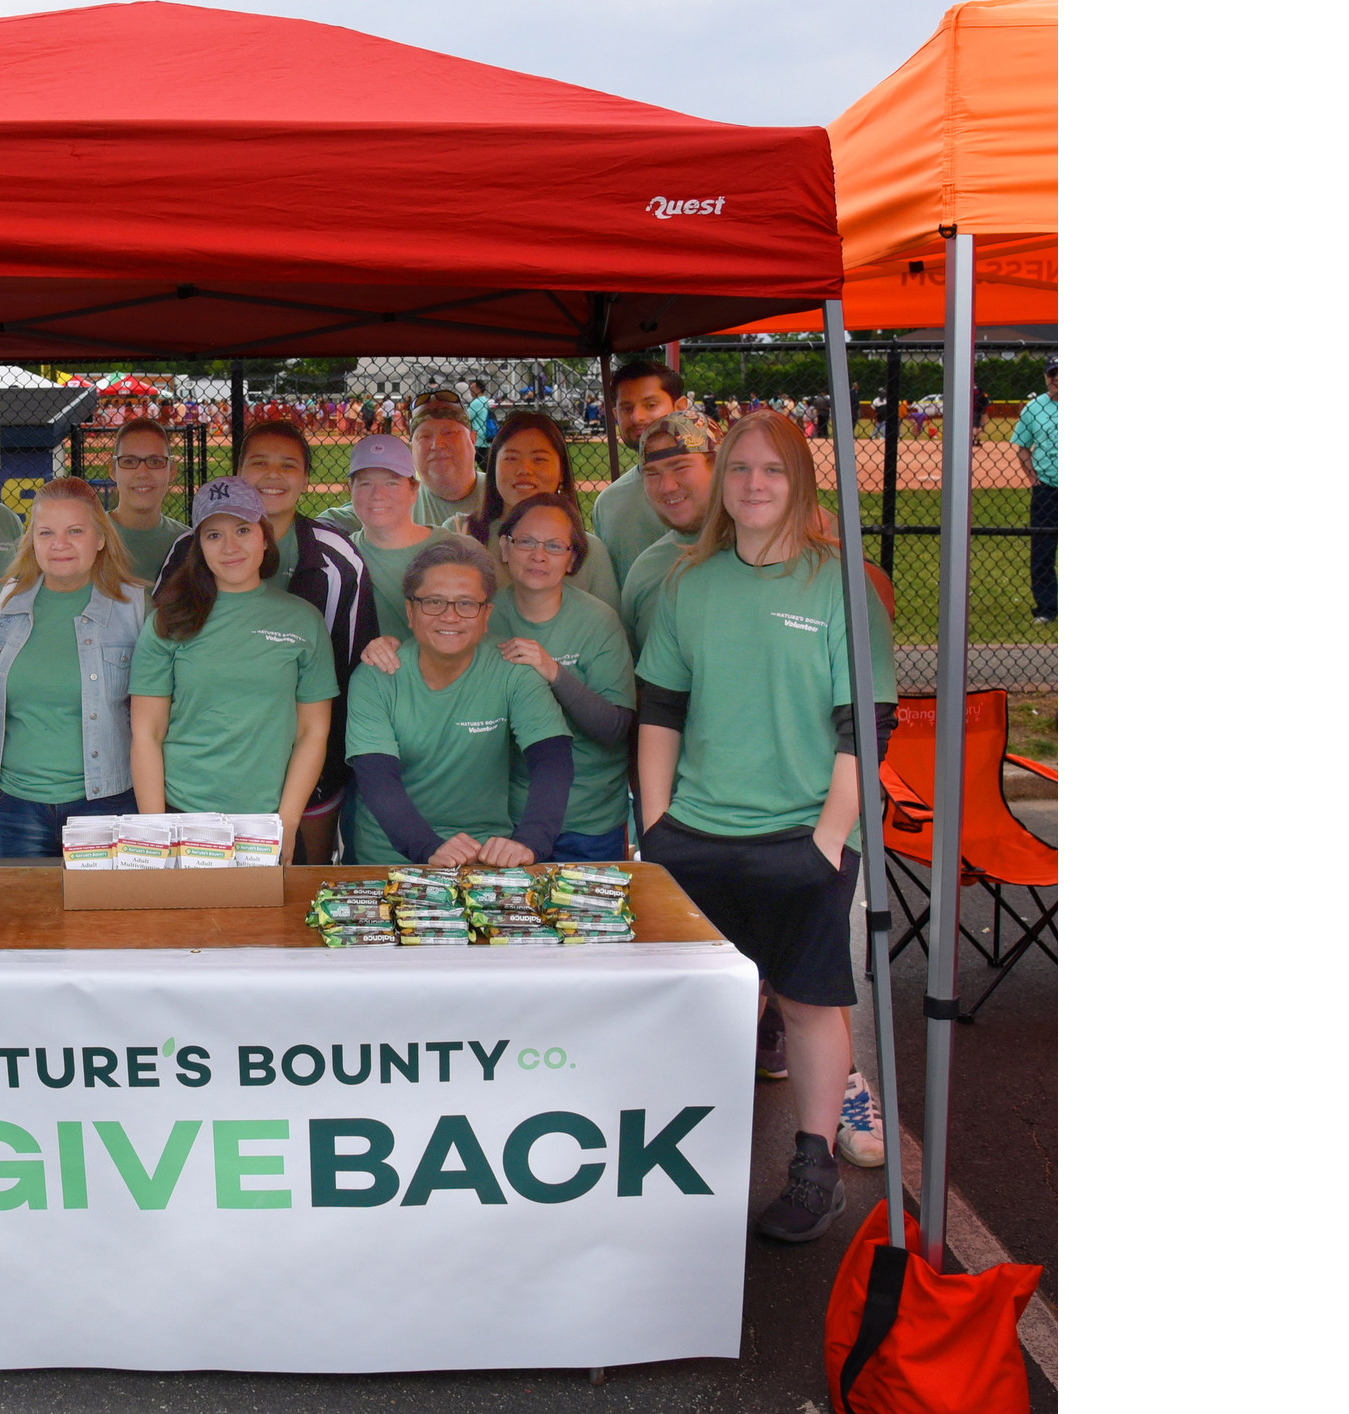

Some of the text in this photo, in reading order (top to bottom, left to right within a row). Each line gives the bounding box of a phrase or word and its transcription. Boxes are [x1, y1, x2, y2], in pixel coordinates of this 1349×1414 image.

[645, 196, 726, 219] Quest
[784, 620, 819, 632] Volunteer
[238, 1039, 511, 1087] BOUNTY
[517, 1046, 577, 1070] CO.
